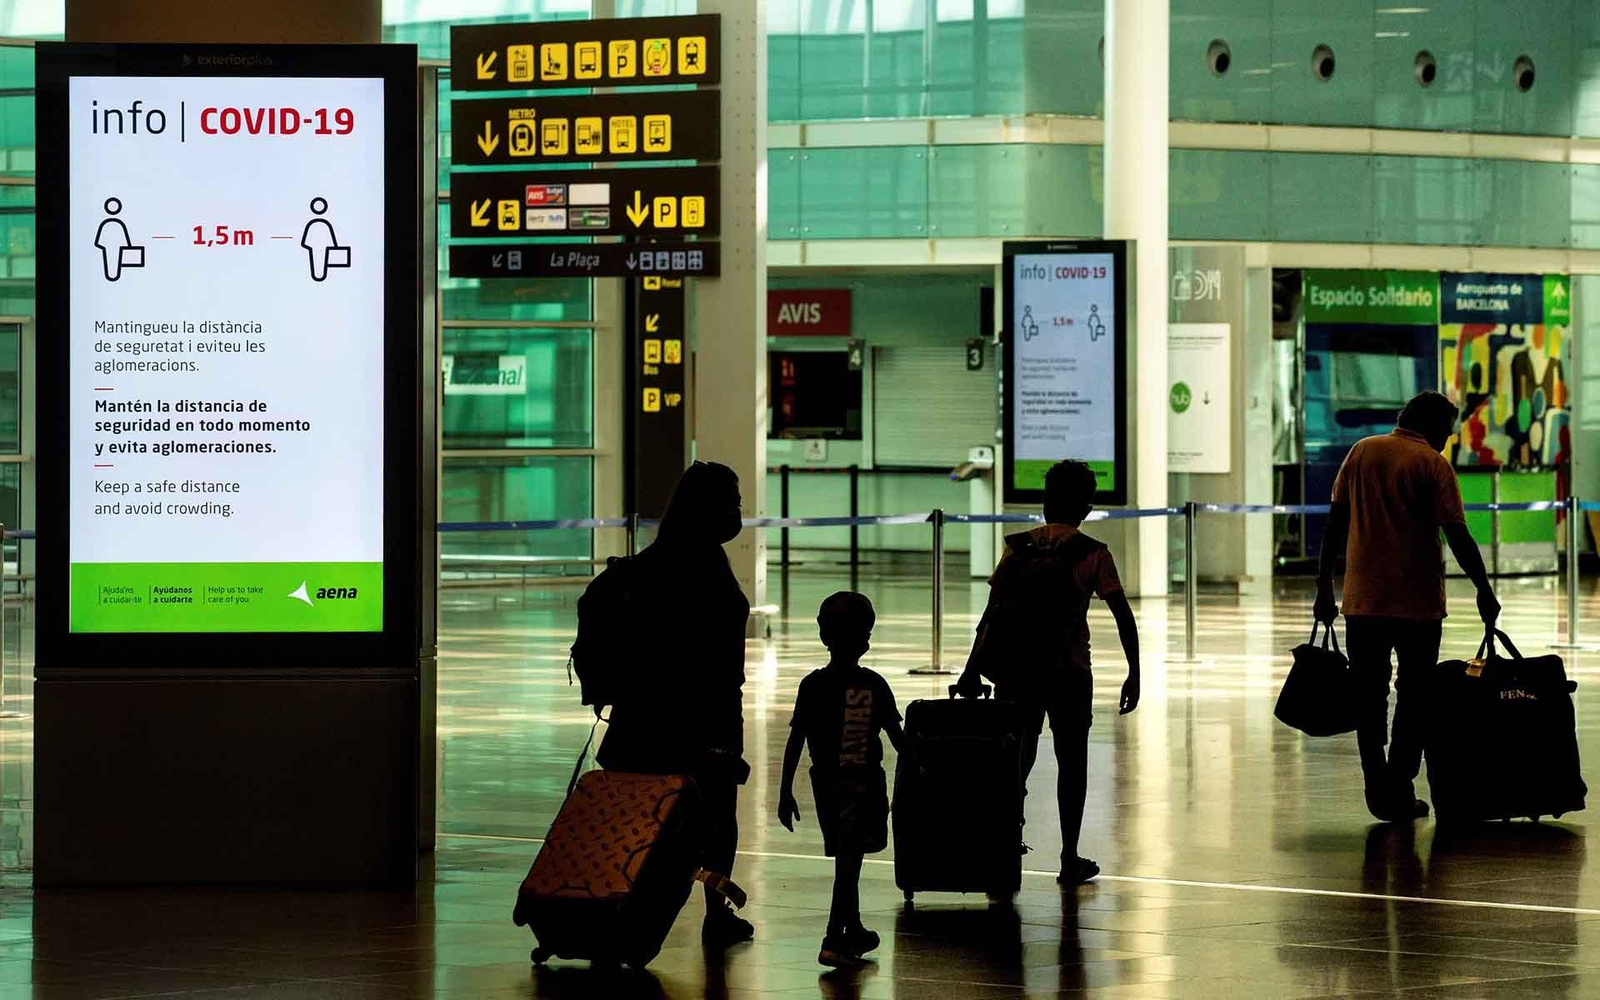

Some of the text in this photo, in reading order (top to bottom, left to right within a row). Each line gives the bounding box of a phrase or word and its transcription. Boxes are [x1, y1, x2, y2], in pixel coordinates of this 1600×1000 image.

[92, 100, 354, 135] info COVID-19
[508, 109, 536, 119] METRO
[611, 119, 634, 128] HOTEL
[550, 252, 600, 270] La Plaça
[1020, 263, 1106, 280] info COVID-19
[1311, 285, 1433, 310] Espacio Solidario
[777, 303, 821, 324] AVIS
[94, 319, 262, 336] Mantingueu la distància
[94, 339, 112, 353] de
[116, 340, 184, 356] seguretat
[196, 340, 241, 353] eviteu
[246, 340, 266, 353] les
[851, 350, 861, 366] 4
[969, 350, 980, 366] 3
[94, 358, 200, 375] aglomeracions.
[94, 400, 267, 413] Mantén la distancia de
[664, 393, 681, 406] VIP
[94, 419, 311, 435] seguridad en todo momento
[94, 440, 277, 457] y evita aglomeraciones.
[94, 480, 240, 496] Keep a safe distance
[94, 502, 234, 518] and avoid crowding.
[153, 585, 193, 595] Ayúdanos
[208, 585, 224, 596] Help
[246, 585, 263, 594] take
[316, 586, 357, 600] aena
[160, 595, 193, 603] cuidarte
[226, 595, 234, 603] of
